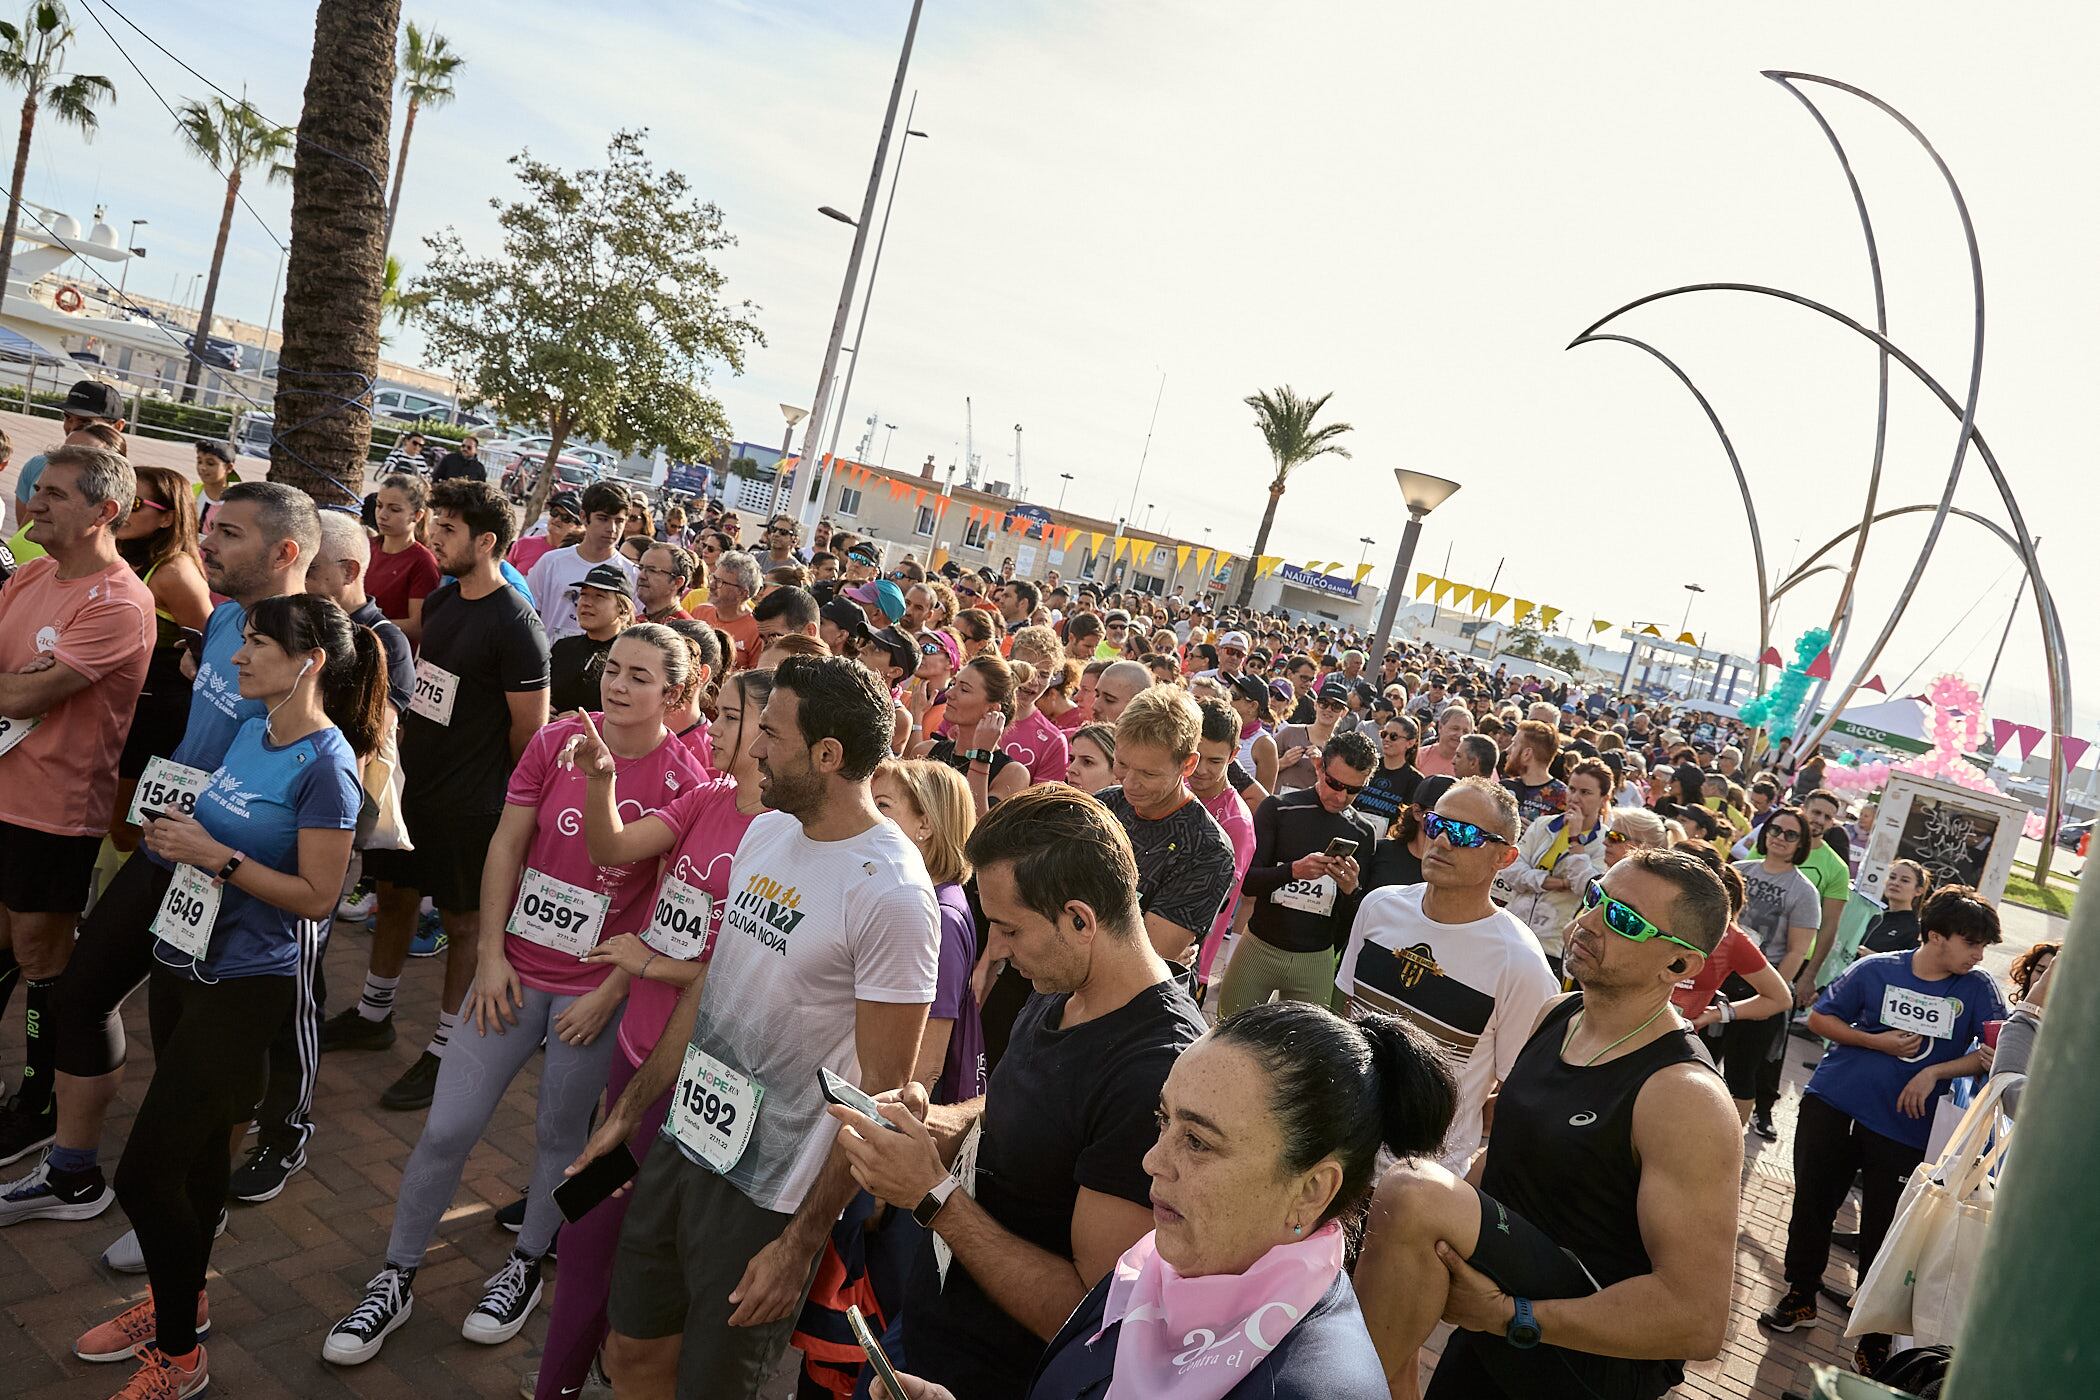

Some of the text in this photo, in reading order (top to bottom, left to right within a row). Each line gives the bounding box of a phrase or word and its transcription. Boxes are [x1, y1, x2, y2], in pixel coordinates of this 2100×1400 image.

[1284, 570, 1353, 596] NAUTICO GANDIA
[415, 677, 444, 704] 0715
[1846, 723, 1887, 741] aecc
[157, 770, 188, 786] HOPE
[140, 780, 196, 815] 1548
[225, 801, 250, 819] GANDIA
[1357, 794, 1397, 813] PINNING
[540, 885, 573, 904] HOPE
[667, 887, 687, 904] HOPE
[1743, 875, 1785, 896] OCKY
[166, 887, 204, 927] 1549
[523, 894, 590, 934] 0597
[655, 898, 702, 939] 0004
[526, 920, 545, 932] Gandia
[590, 914, 603, 947] APORTANDO
[728, 910, 758, 938] OLIVA
[757, 926, 786, 956] NOVA
[1889, 1000, 1940, 1023] 1696
[672, 1066, 687, 1109] APORTANDO
[698, 1067, 729, 1094] HOPE
[728, 1085, 740, 1096] RUN
[682, 1078, 736, 1137] 1592
[684, 1115, 728, 1150] Gandia 27.11.22
[737, 1111, 756, 1156] APORTANDO
[1226, 1350, 1244, 1369] el
